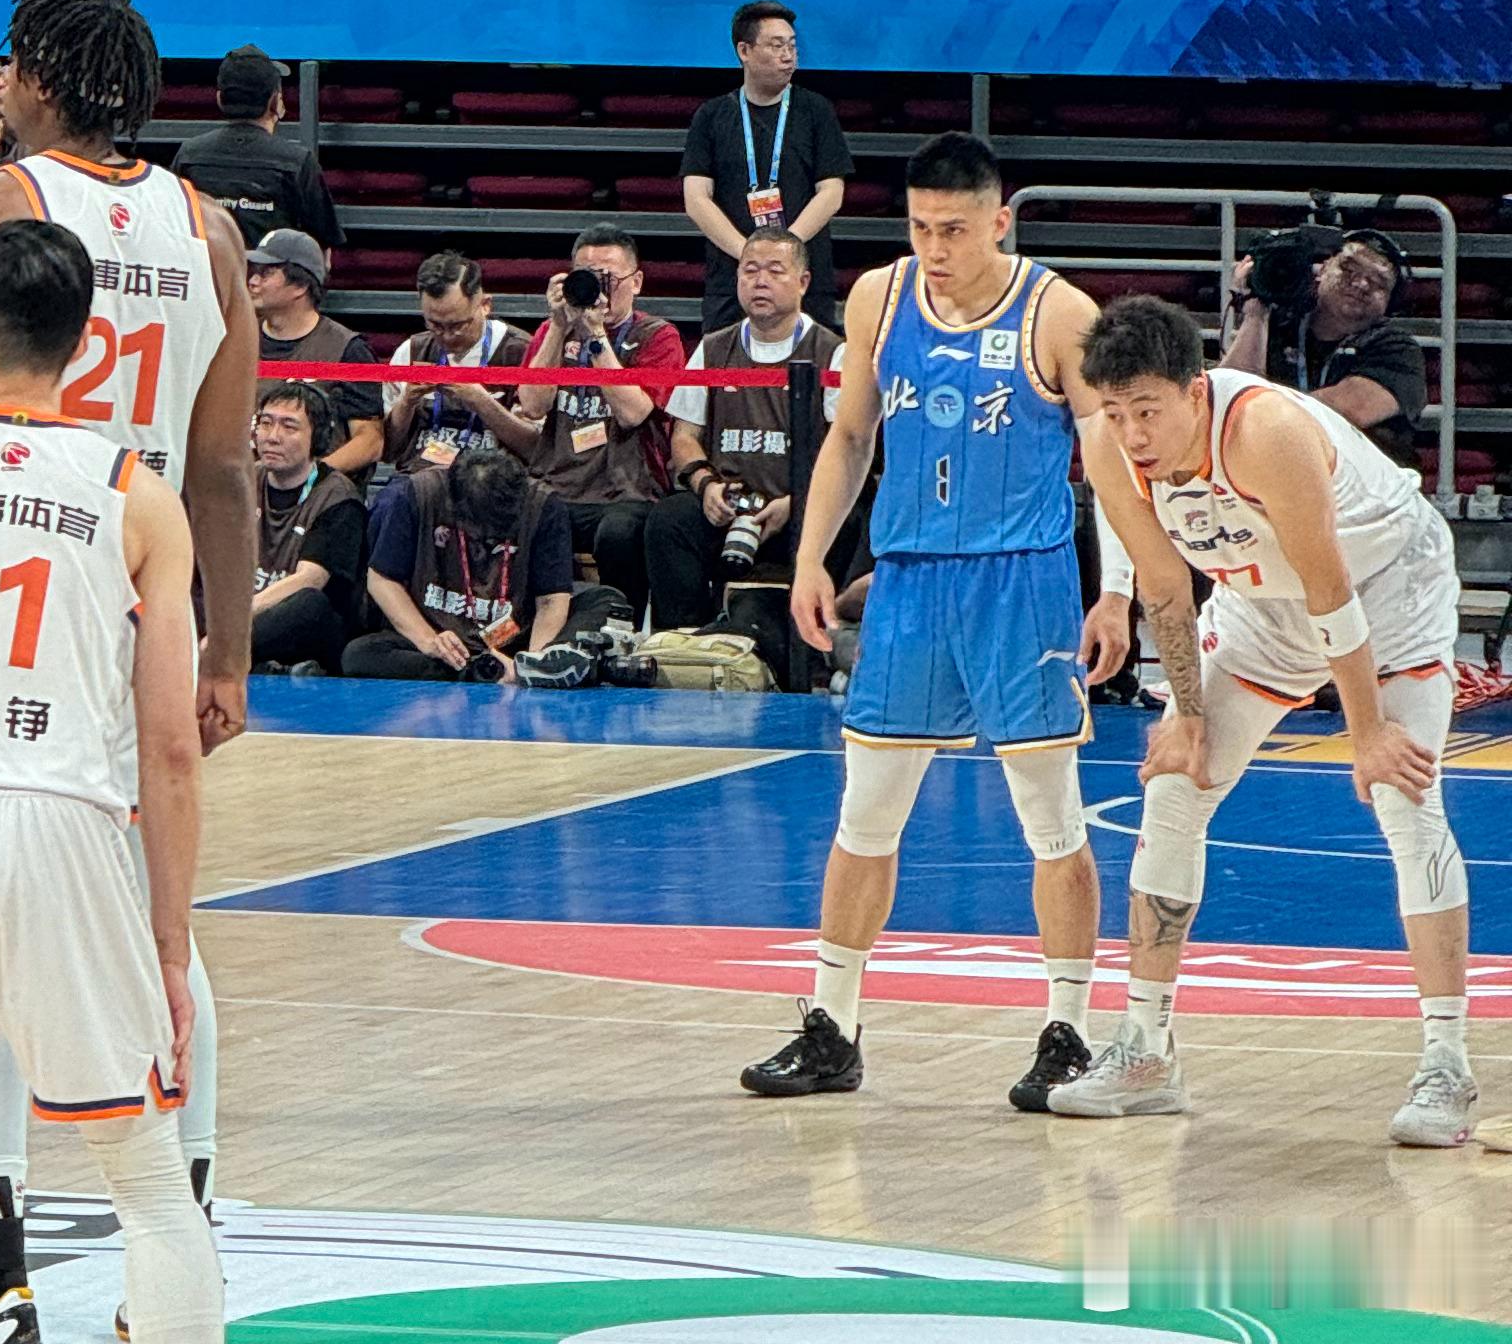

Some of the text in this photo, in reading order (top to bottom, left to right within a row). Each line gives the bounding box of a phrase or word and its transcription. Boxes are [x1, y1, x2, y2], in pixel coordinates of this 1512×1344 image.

[238, 197, 274, 212] Guard
[61, 313, 165, 426] 21
[883, 374, 1017, 436] 北京
[720, 428, 790, 455] 摄影摄
[935, 453, 951, 508] 1
